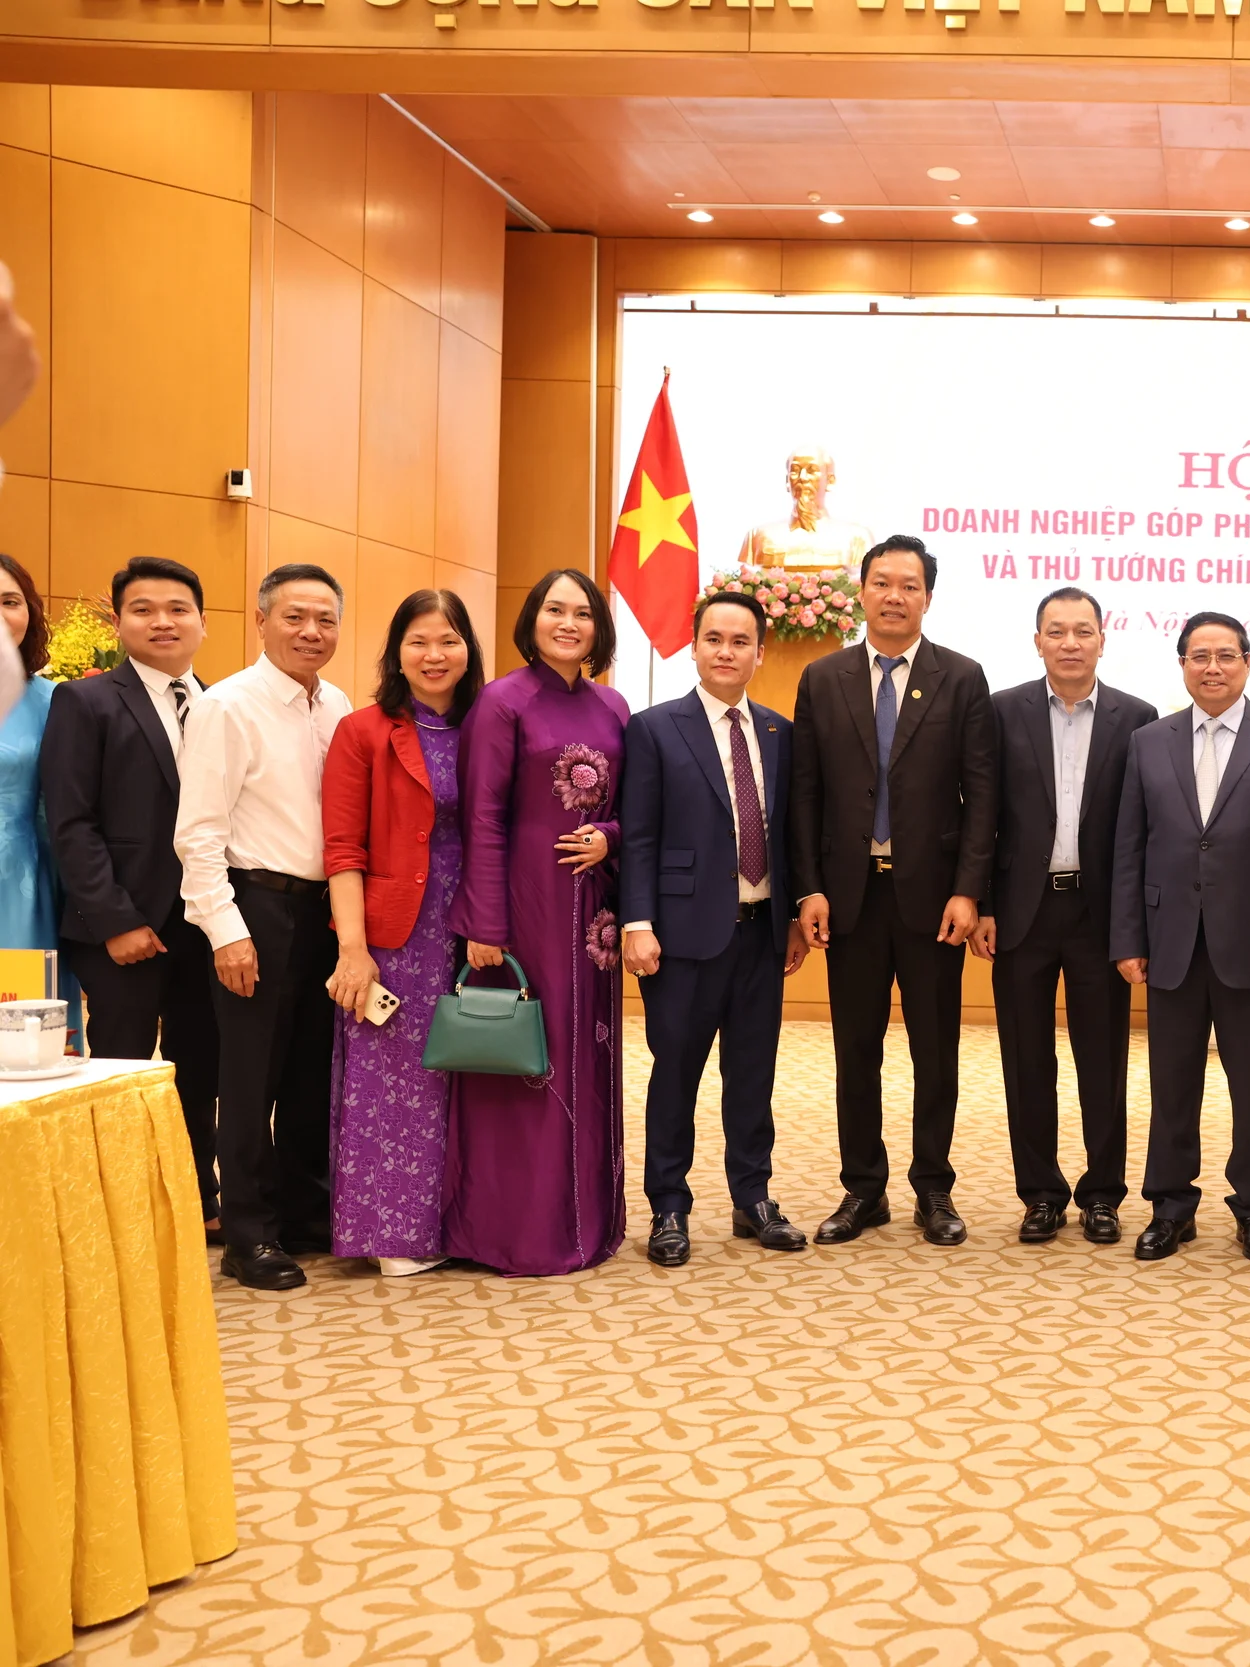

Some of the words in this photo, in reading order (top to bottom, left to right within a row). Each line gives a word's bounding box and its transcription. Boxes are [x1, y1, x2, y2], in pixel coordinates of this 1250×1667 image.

[922, 507, 1020, 534] DOANH
[1030, 506, 1136, 541] NGHIỆP
[1146, 506, 1203, 537] GÓP
[982, 550, 1018, 580] VÀ
[1028, 547, 1081, 582] THỦ
[1091, 552, 1185, 583] TƯỚNG
